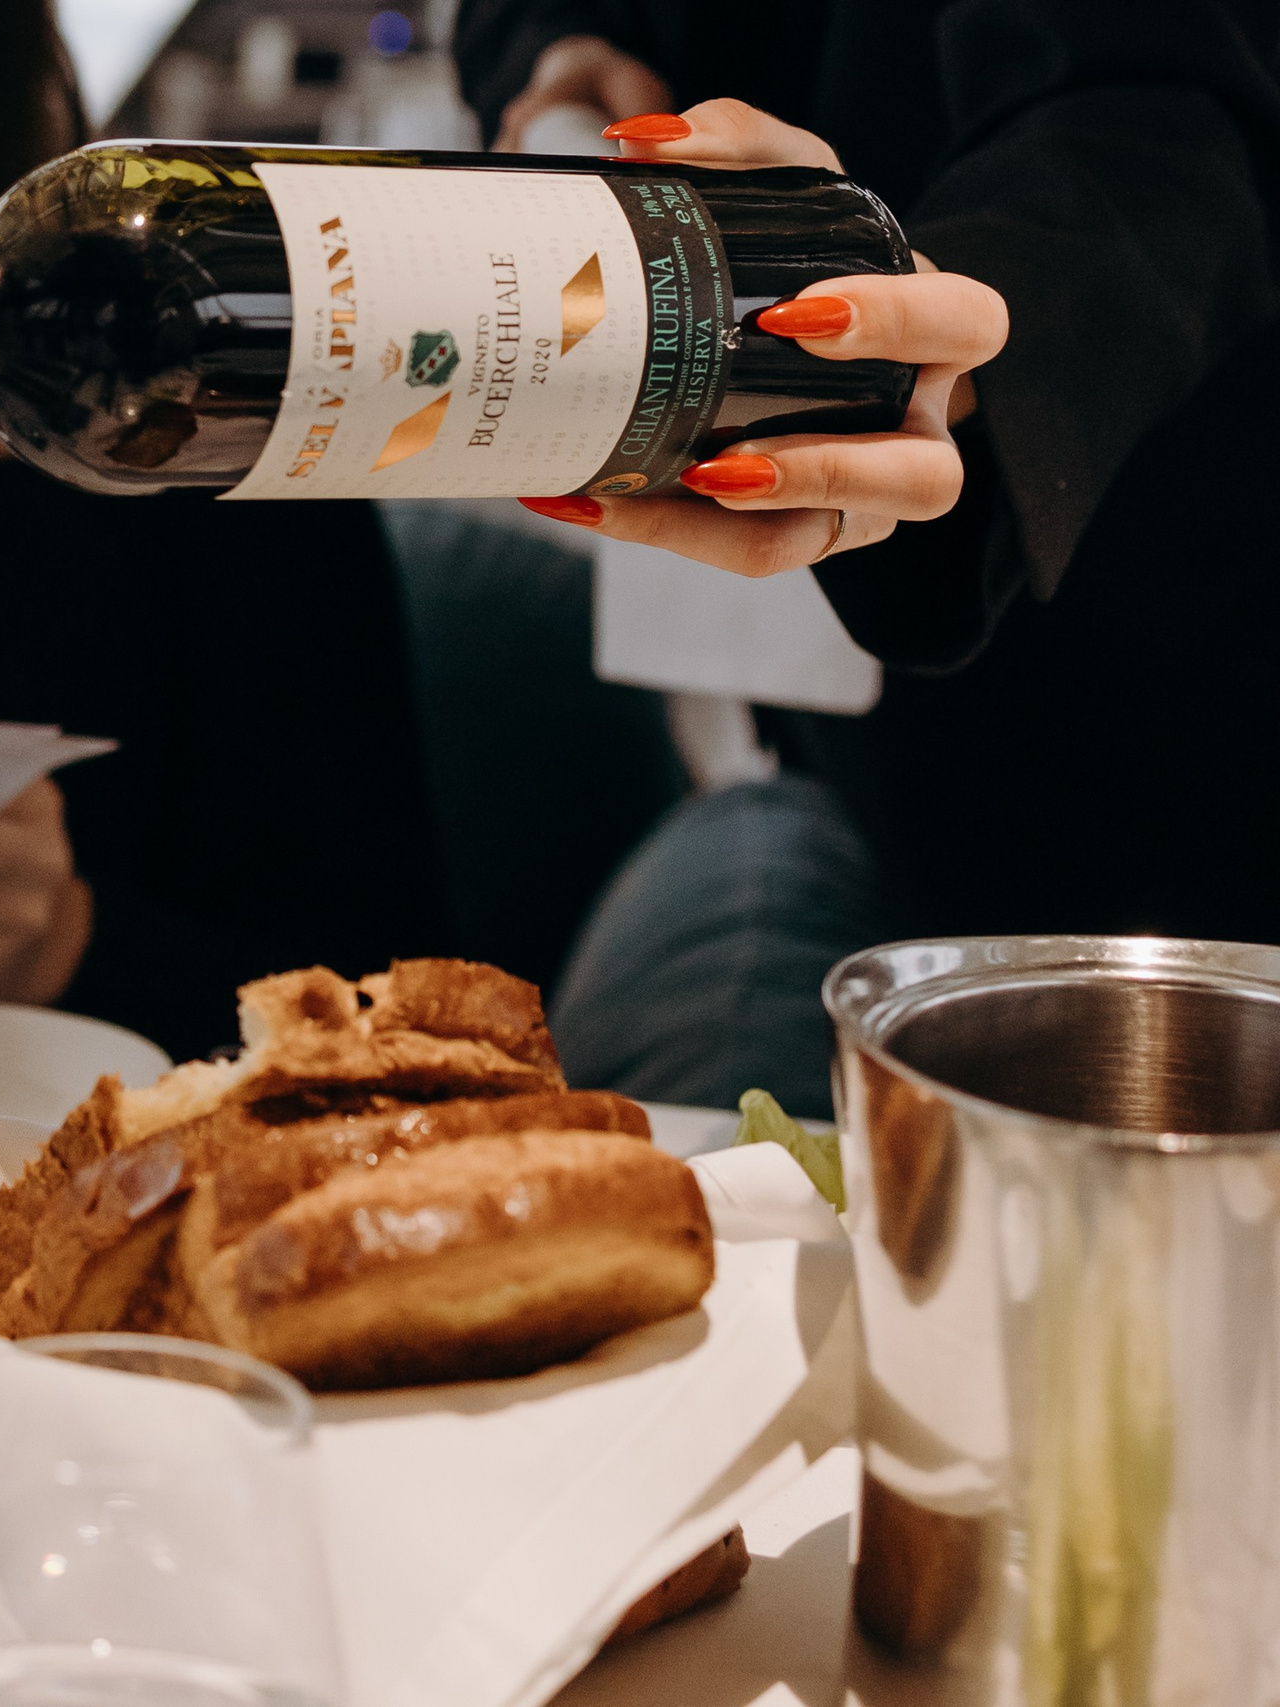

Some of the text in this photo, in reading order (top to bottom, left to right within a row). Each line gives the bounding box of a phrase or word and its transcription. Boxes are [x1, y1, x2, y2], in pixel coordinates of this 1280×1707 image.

[629, 184, 665, 218] 14% vol.
[653, 185, 676, 195] ml
[662, 195, 686, 209] 750
[676, 185, 692, 202] ITALIA
[690, 207, 707, 231] RUFINA
[672, 235, 690, 284] GARANTITA
[703, 237, 718, 267] MASSETI
[647, 255, 679, 353] RUFINA
[713, 280, 724, 318] GIUNTINI
[285, 216, 358, 479] SELVPIANA
[606, 306, 617, 349] 1999
[629, 303, 641, 349] 2007
[683, 295, 693, 361] CONTROLLATA
[468, 252, 521, 448] BUCERCHIALE
[468, 313, 490, 399] VIGNETO
[530, 336, 553, 386] 2020
[683, 317, 712, 408] RISERVA
[713, 364, 721, 376] DA
[615, 370, 634, 414] 2006
[675, 362, 690, 401] ORIGINE
[700, 378, 718, 420] PRODOTTO
[620, 362, 676, 456] CHIANTI
[671, 401, 682, 412] DI
[639, 413, 676, 471] DENOMINAZIONE
